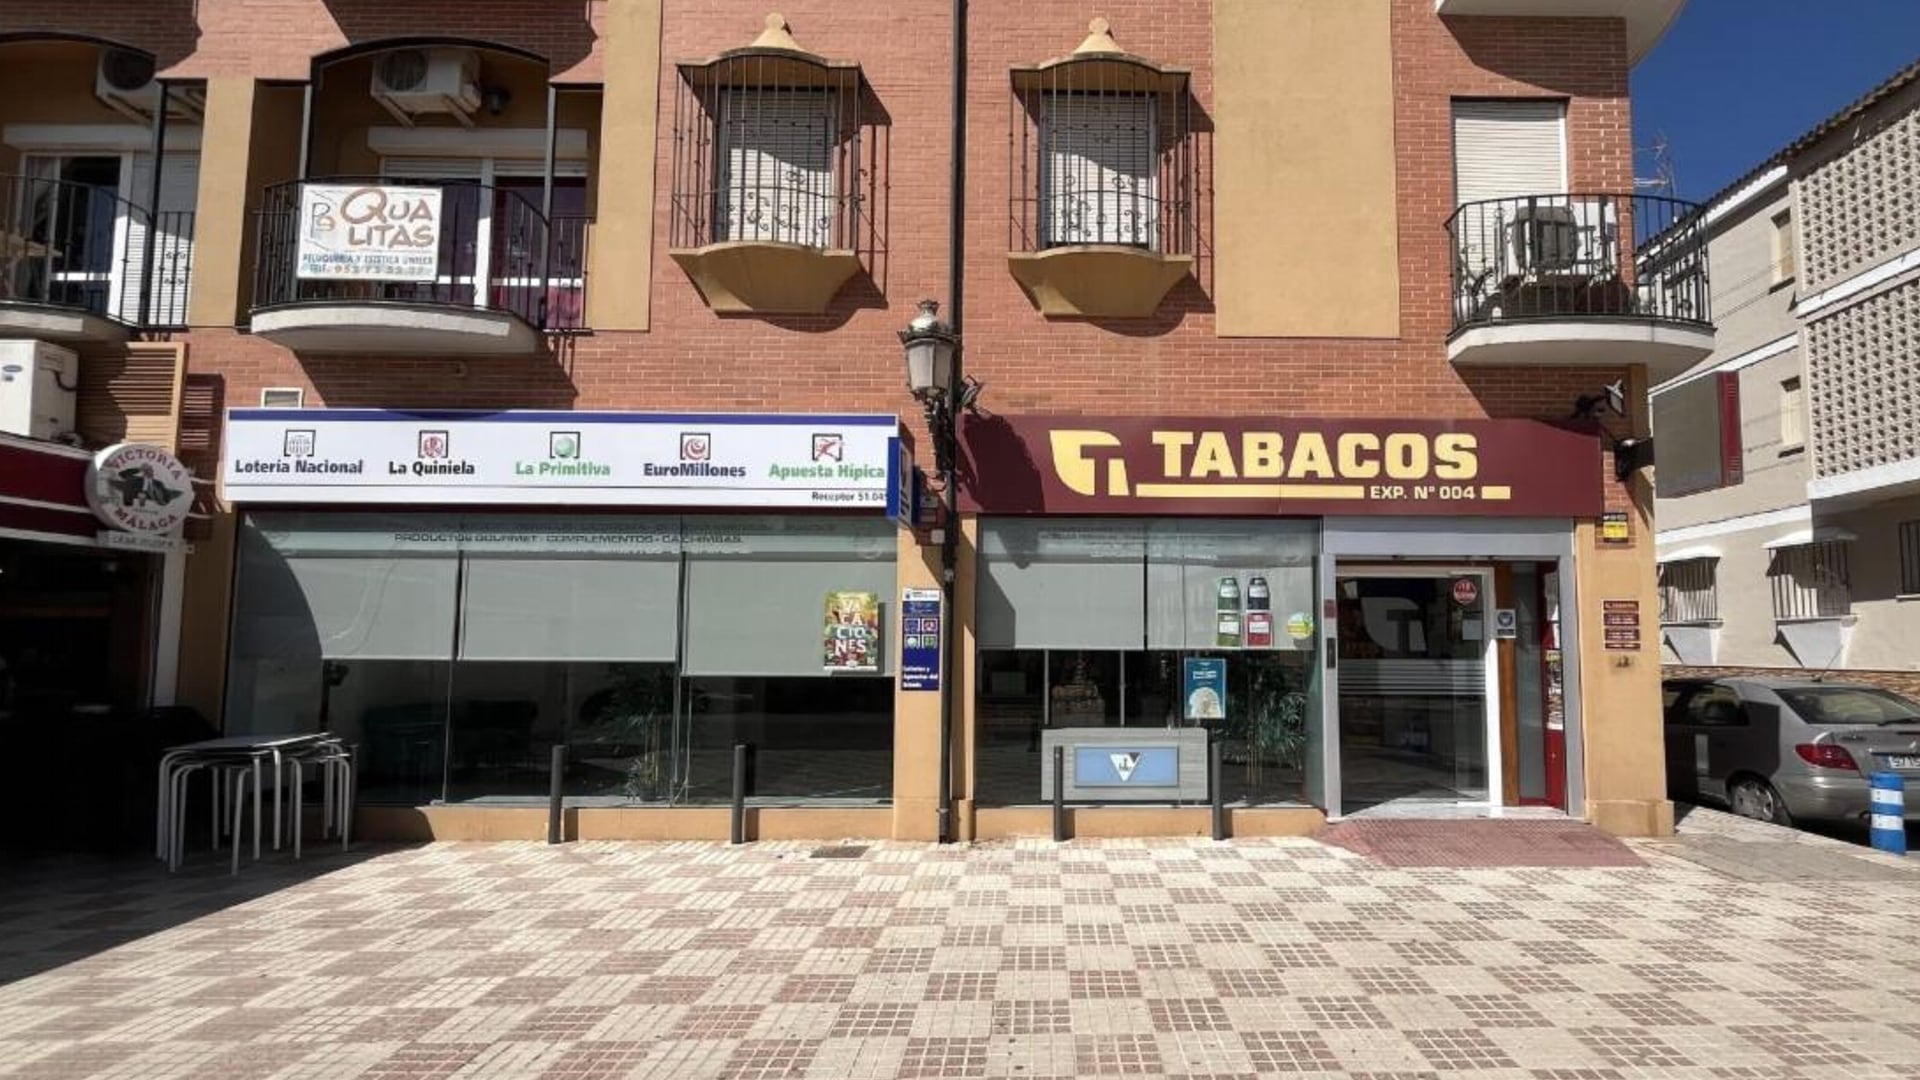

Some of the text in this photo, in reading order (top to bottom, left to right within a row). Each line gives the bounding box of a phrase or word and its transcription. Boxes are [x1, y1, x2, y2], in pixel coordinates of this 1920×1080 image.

[341, 187, 433, 224] QUA
[348, 224, 434, 249] LITAS
[1151, 431, 1479, 480] TABACOS
[106, 448, 182, 480] VICTORIA
[295, 459, 364, 474] Nacional
[388, 460, 475, 476] La Quiniela
[515, 461, 611, 476] La Primitiva
[643, 462, 746, 478] EuroMillones
[768, 463, 833, 481] Apuesta
[811, 491, 855, 502] Receptor
[1370, 485, 1408, 500] EXP.
[1439, 485, 1476, 500] 004
[394, 532, 472, 543] PRODUCTOS
[474, 533, 537, 543] GOURMET
[545, 534, 653, 544] COMPLEMENTOS
[662, 534, 744, 544] CACHIMBAS
[841, 599, 863, 613] VA
[840, 612, 863, 626] CA
[836, 625, 866, 639] CIO
[835, 639, 866, 657] NES
